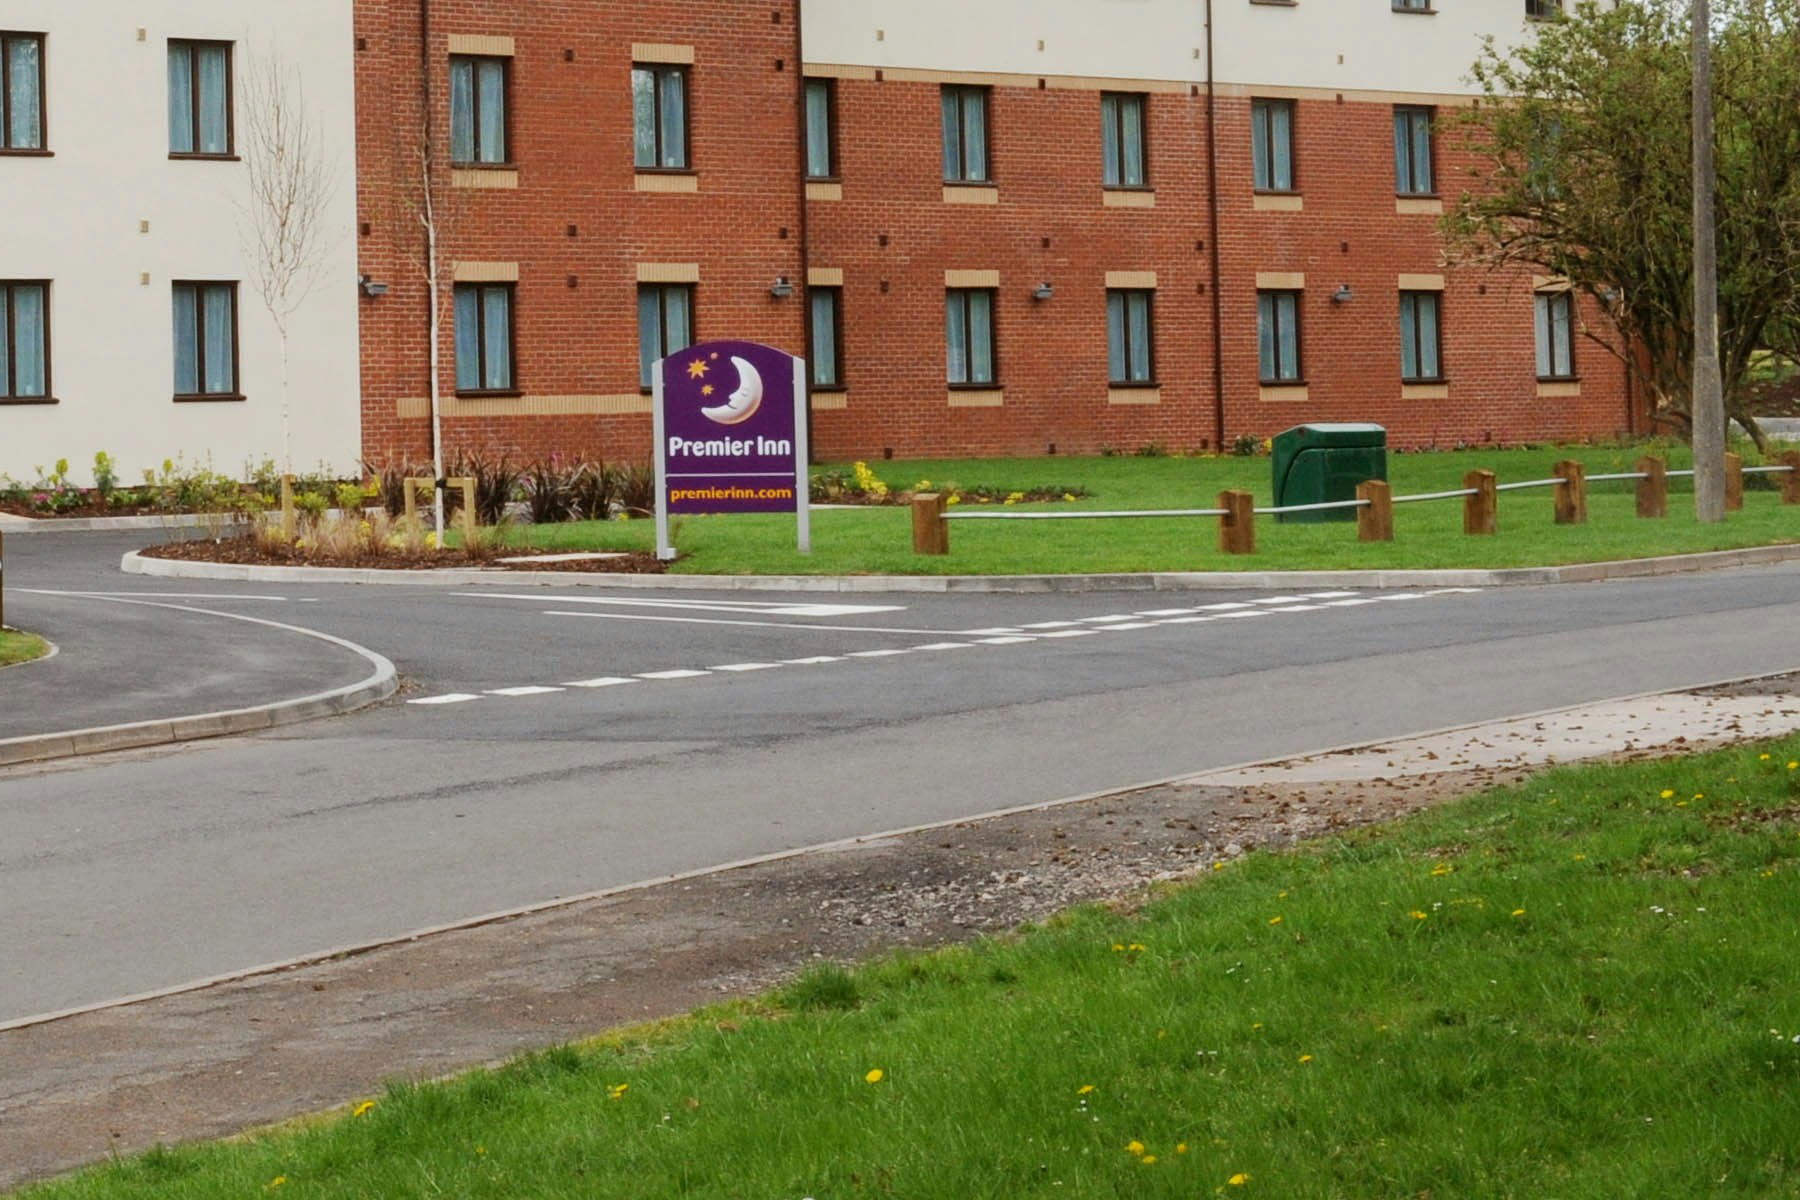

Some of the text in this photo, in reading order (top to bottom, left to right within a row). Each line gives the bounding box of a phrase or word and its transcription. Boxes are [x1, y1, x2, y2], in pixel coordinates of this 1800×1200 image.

[669, 435, 790, 457] Premier Inn
[670, 486, 792, 502] premierinn.com
